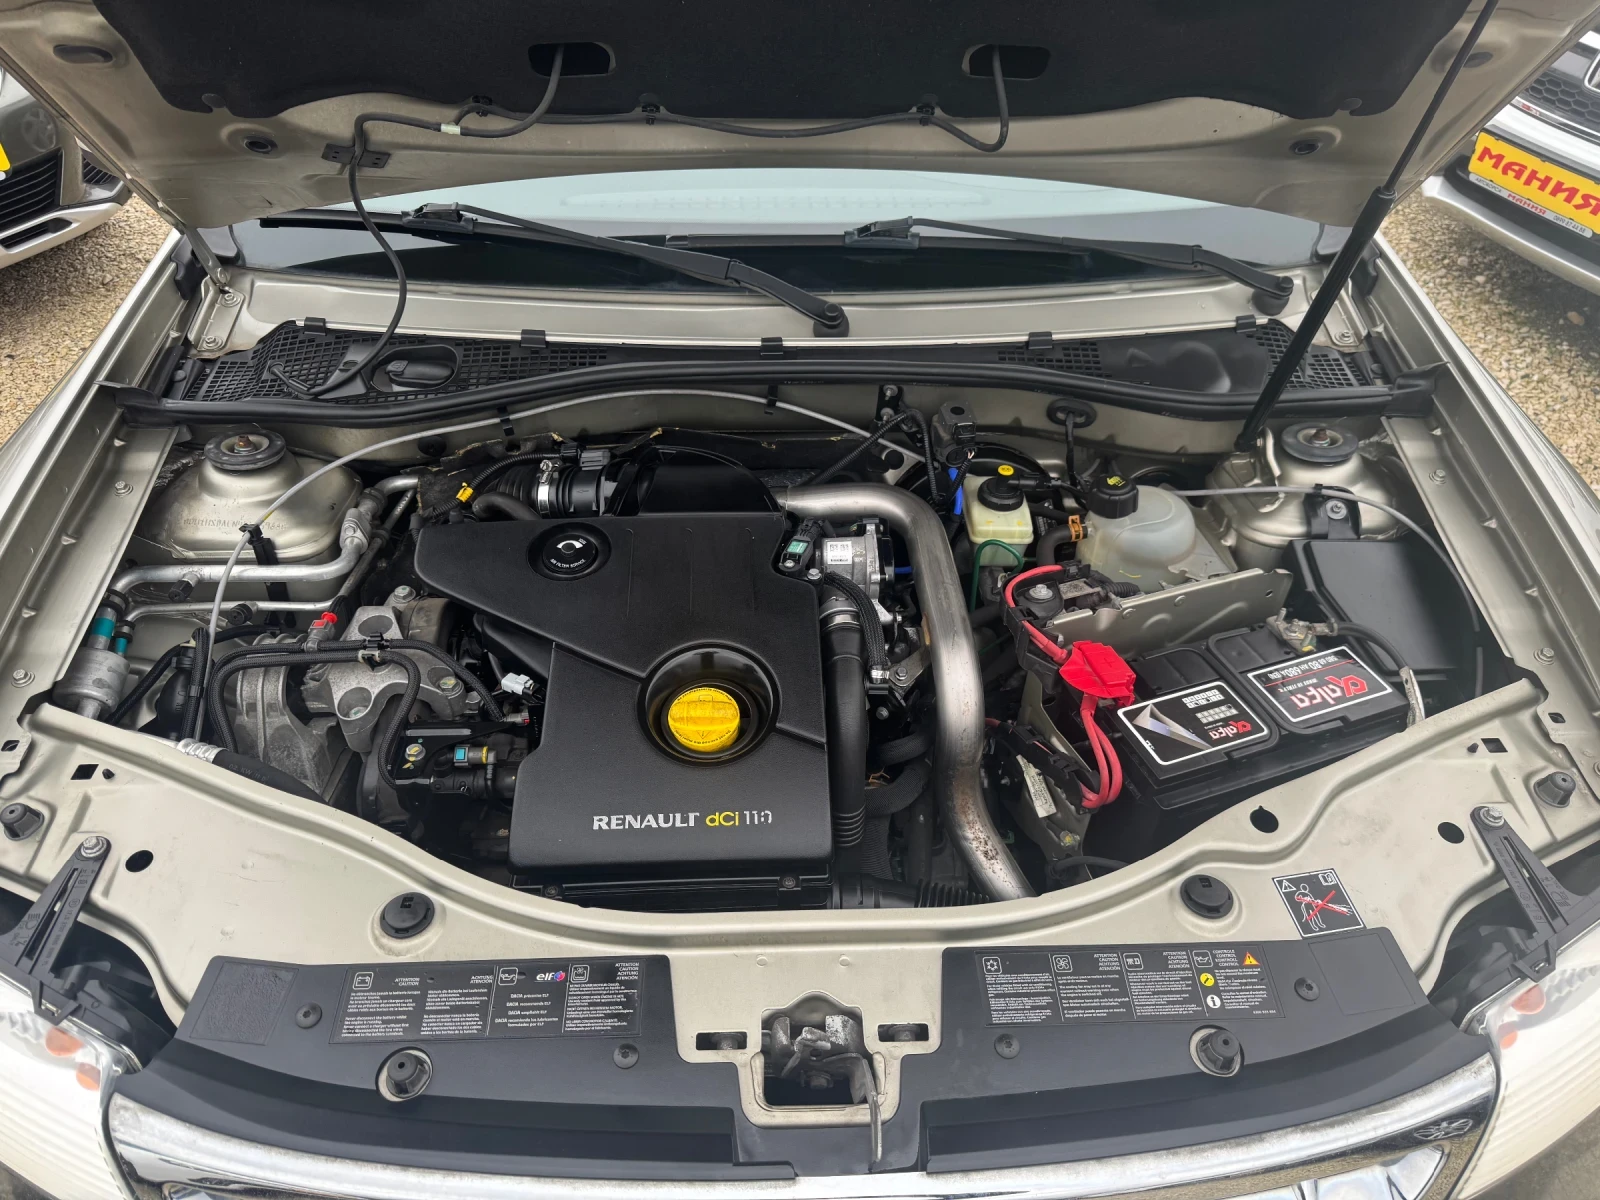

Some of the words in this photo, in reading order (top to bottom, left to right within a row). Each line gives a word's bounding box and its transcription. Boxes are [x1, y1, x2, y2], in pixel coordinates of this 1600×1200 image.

[1477, 146, 1600, 217] МАНИЯ
[1507, 193, 1547, 216] МАНИЯ
[1308, 661, 1322, 670] 80
[592, 812, 700, 830] RENAULT
[706, 811, 739, 827] dCi
[536, 972, 555, 981] elf
